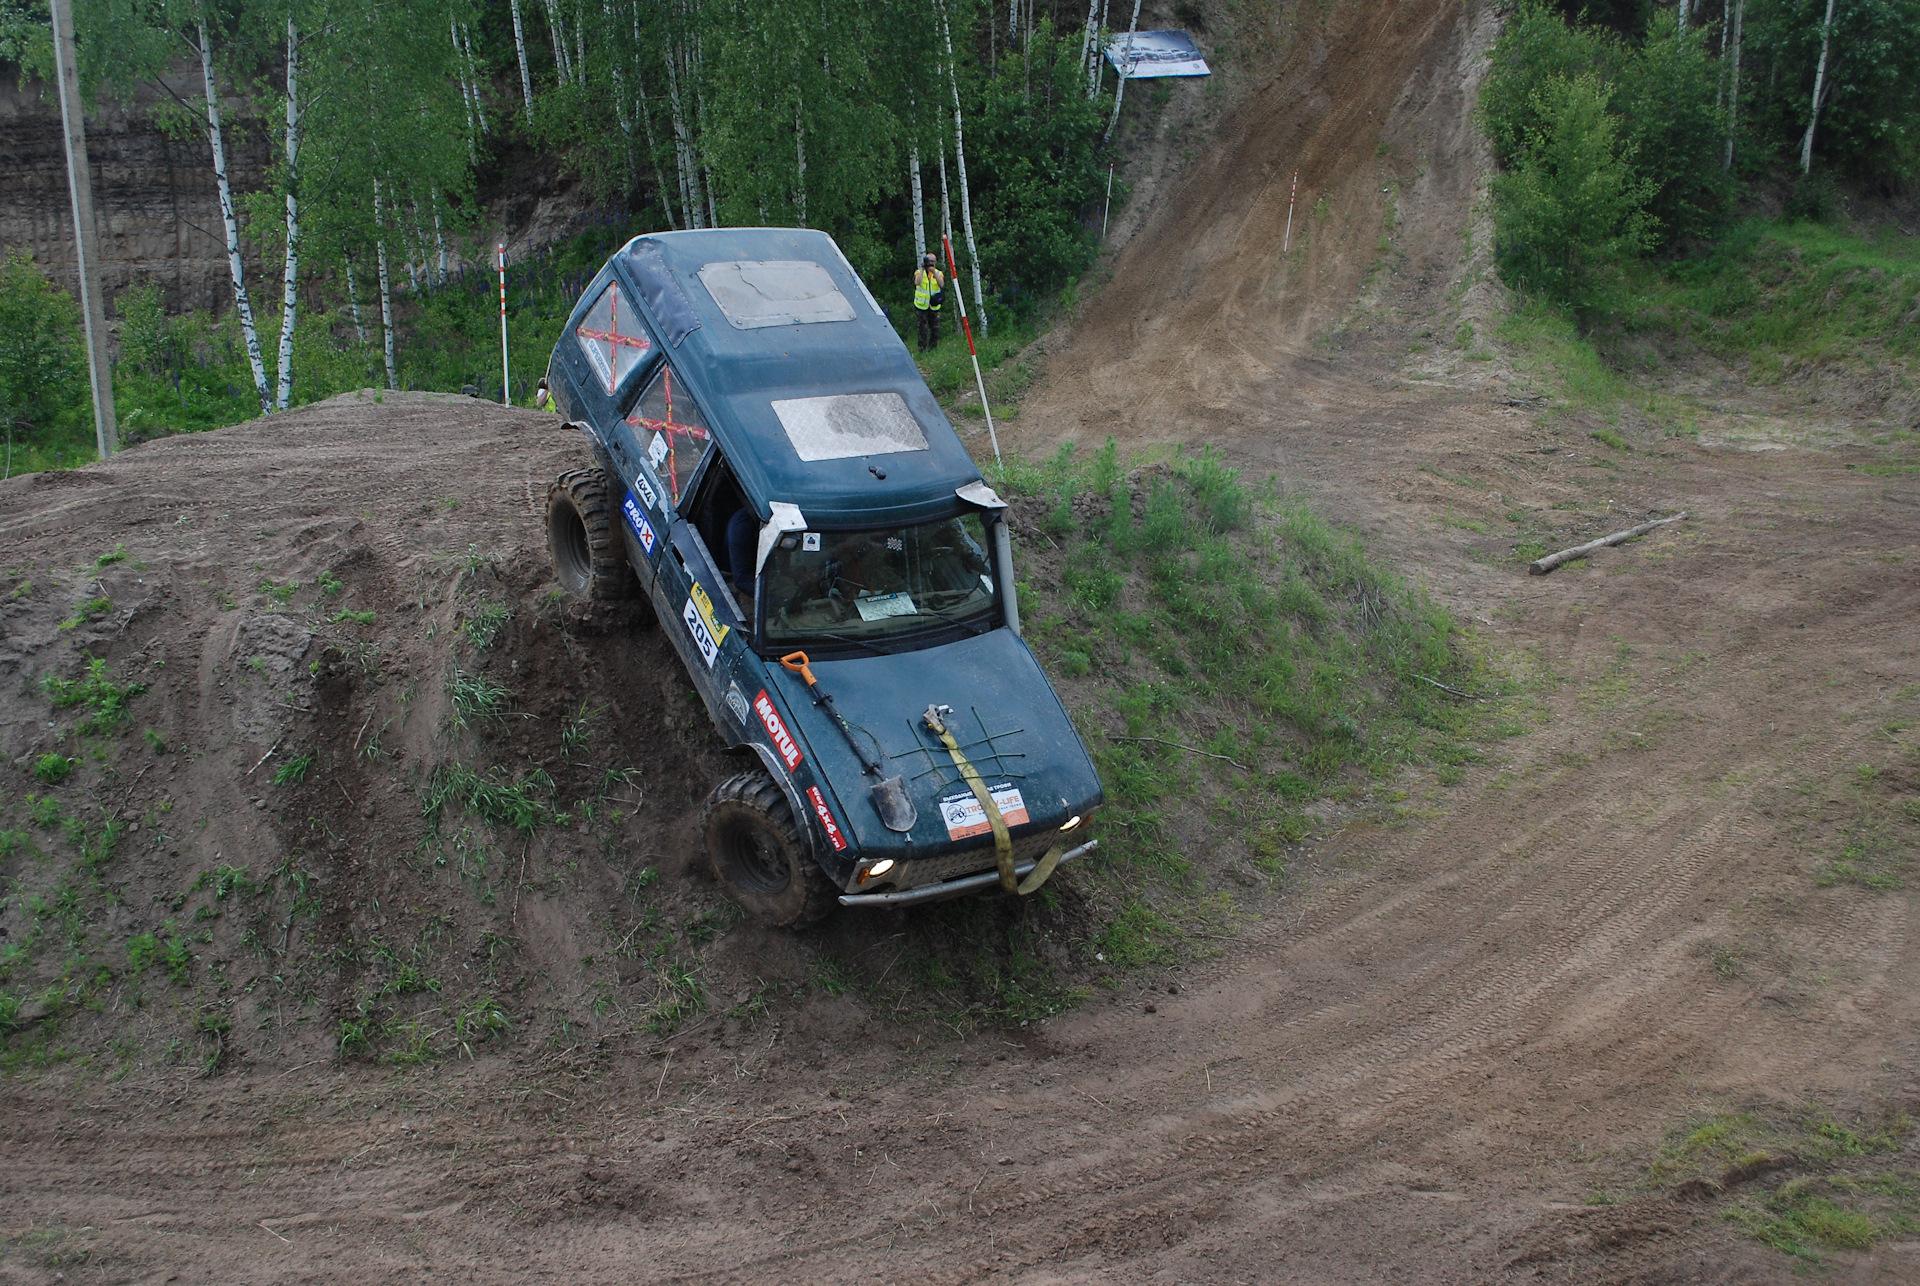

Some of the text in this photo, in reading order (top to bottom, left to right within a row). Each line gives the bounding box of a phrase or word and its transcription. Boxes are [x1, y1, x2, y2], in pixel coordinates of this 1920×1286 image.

[687, 609, 713, 657] 205
[756, 697, 800, 767] MOTUL
[966, 795, 1019, 813] TROY-LIFE
